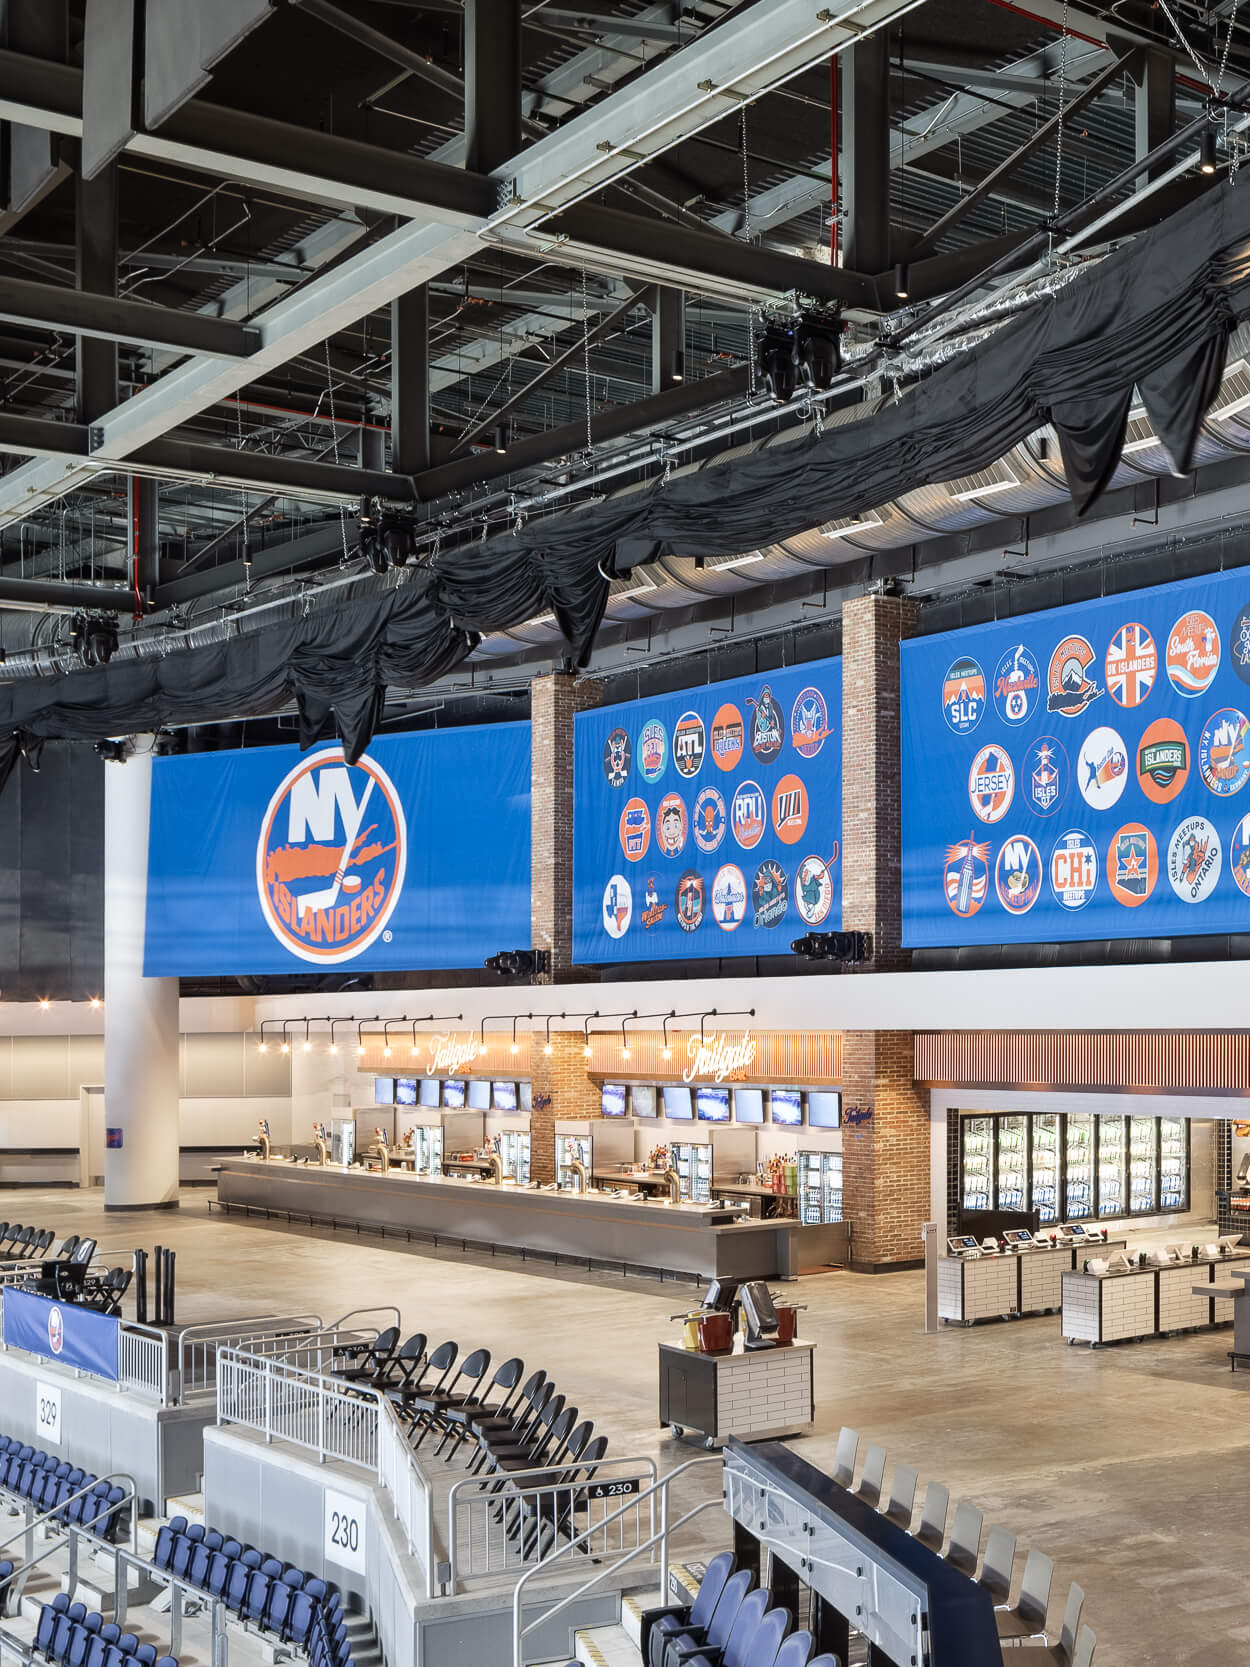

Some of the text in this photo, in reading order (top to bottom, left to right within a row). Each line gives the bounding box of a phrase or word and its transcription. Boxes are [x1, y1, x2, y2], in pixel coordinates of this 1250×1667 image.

[1169, 636, 1195, 656] South
[1107, 656, 1155, 676] UK ISLANDERS
[1186, 651, 1218, 671] Florida
[995, 674, 1039, 698] Nashville
[951, 701, 977, 724] SLC
[676, 734, 702, 757] ATL
[715, 736, 741, 753] QUEENS
[754, 729, 782, 747] BOSTON
[1213, 720, 1241, 763] NY
[1145, 750, 1182, 767] ISLANDERS
[1201, 749, 1222, 792] ISLANDERS
[971, 774, 1010, 794] JERSEY
[1035, 786, 1056, 798] ISLES
[288, 766, 376, 897] NY
[1175, 822, 1205, 849] MEETUPS
[1005, 842, 1032, 886] NY
[1191, 847, 1218, 898] ONTARIO
[270, 868, 385, 942] ISLANDERS
[754, 902, 788, 929] Orlando
[426, 1031, 479, 1076] Tailgate
[683, 1029, 757, 1083] Tailgate
[729, 1071, 747, 1081] BAR
[40, 1398, 57, 1427] 329
[608, 1483, 632, 1495] 230
[331, 1511, 359, 1552] 230
